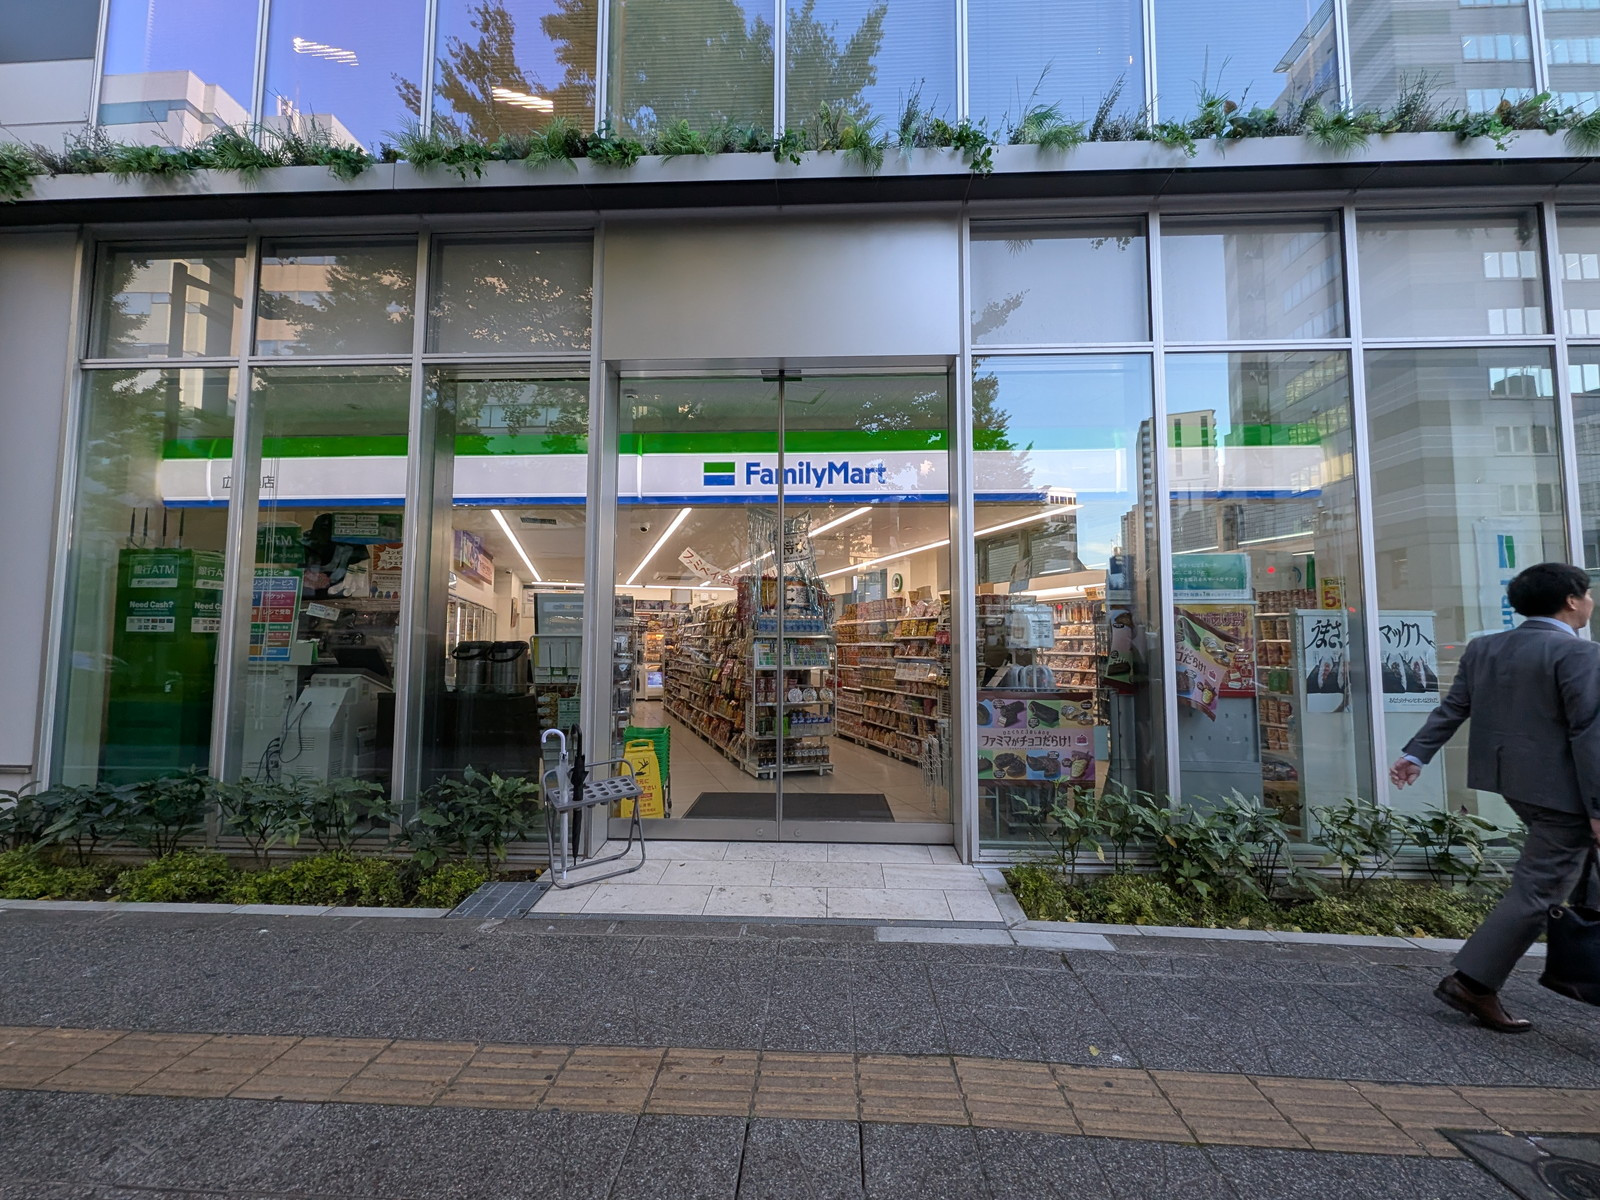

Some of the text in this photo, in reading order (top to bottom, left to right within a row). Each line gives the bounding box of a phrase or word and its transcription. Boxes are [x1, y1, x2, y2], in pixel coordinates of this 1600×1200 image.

[746, 461, 886, 489] FamilyMart
[194, 602, 213, 610] Need
[981, 735, 1071, 748] ファミマがチョコだらけ!
